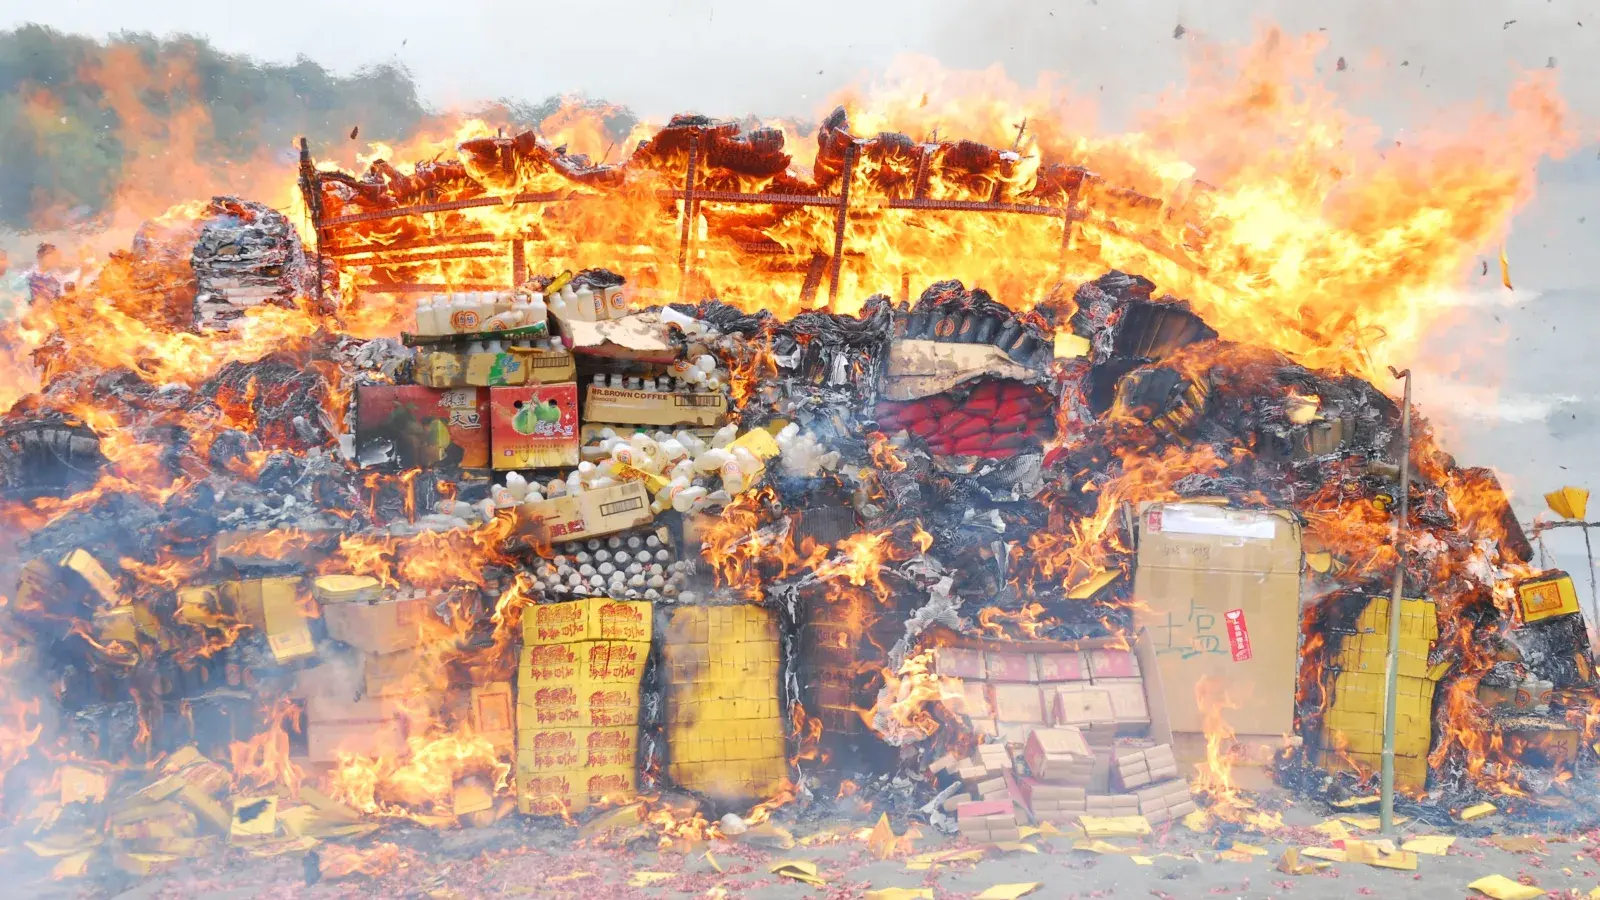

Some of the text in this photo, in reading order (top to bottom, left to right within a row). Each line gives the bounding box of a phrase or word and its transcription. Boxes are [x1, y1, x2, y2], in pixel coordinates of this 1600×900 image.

[591, 388, 668, 400] MR.BROWN COFFEE
[448, 410, 481, 429] 文旦
